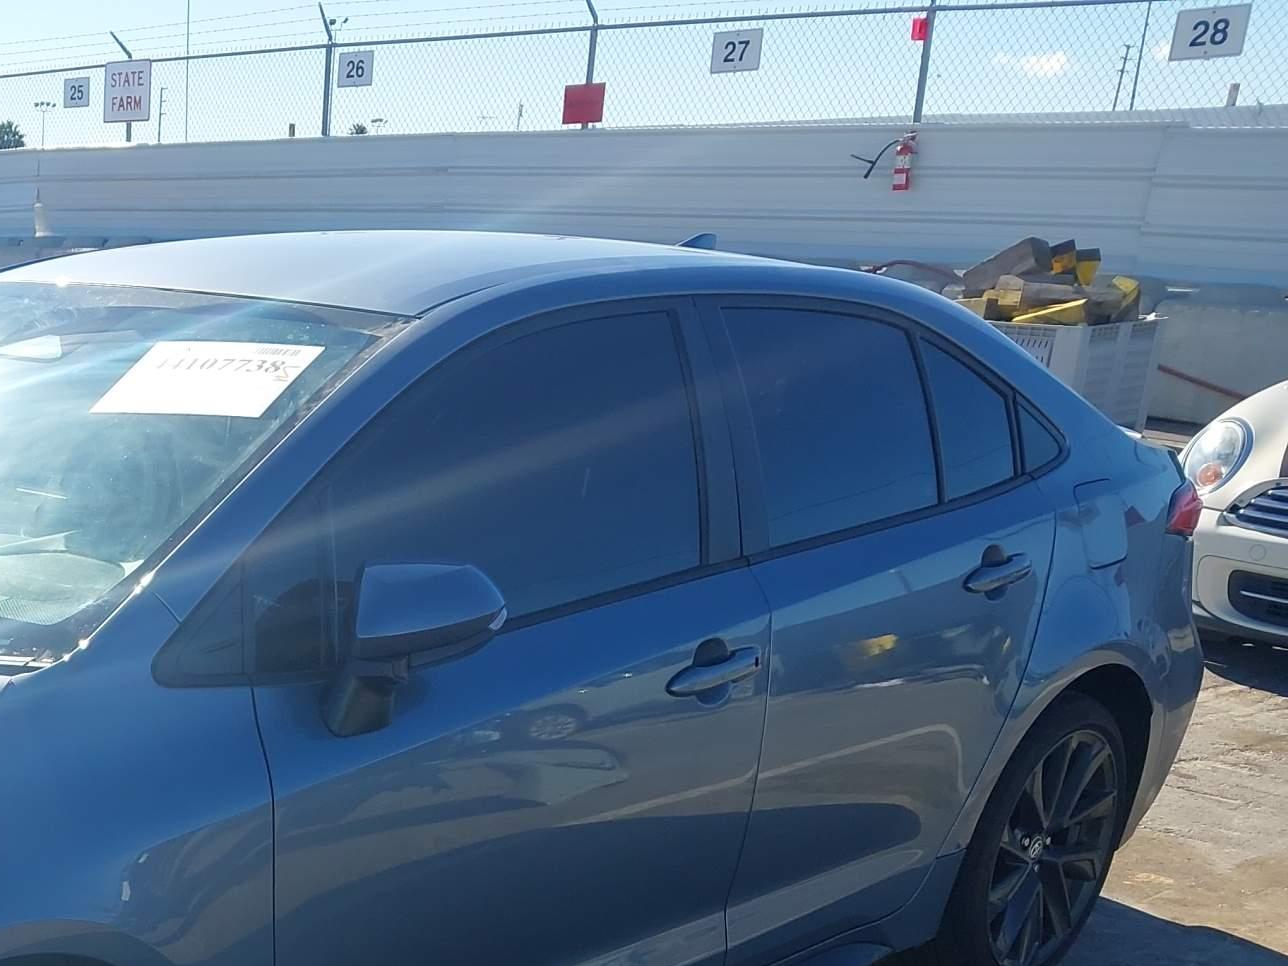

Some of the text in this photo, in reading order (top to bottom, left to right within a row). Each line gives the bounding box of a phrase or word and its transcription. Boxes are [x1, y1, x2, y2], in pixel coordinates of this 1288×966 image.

[1188, 18, 1230, 47] 28
[723, 40, 750, 63] 27
[345, 60, 365, 79] 26
[110, 70, 145, 88] STATE
[70, 84, 84, 101] 25
[111, 95, 142, 112] FARM
